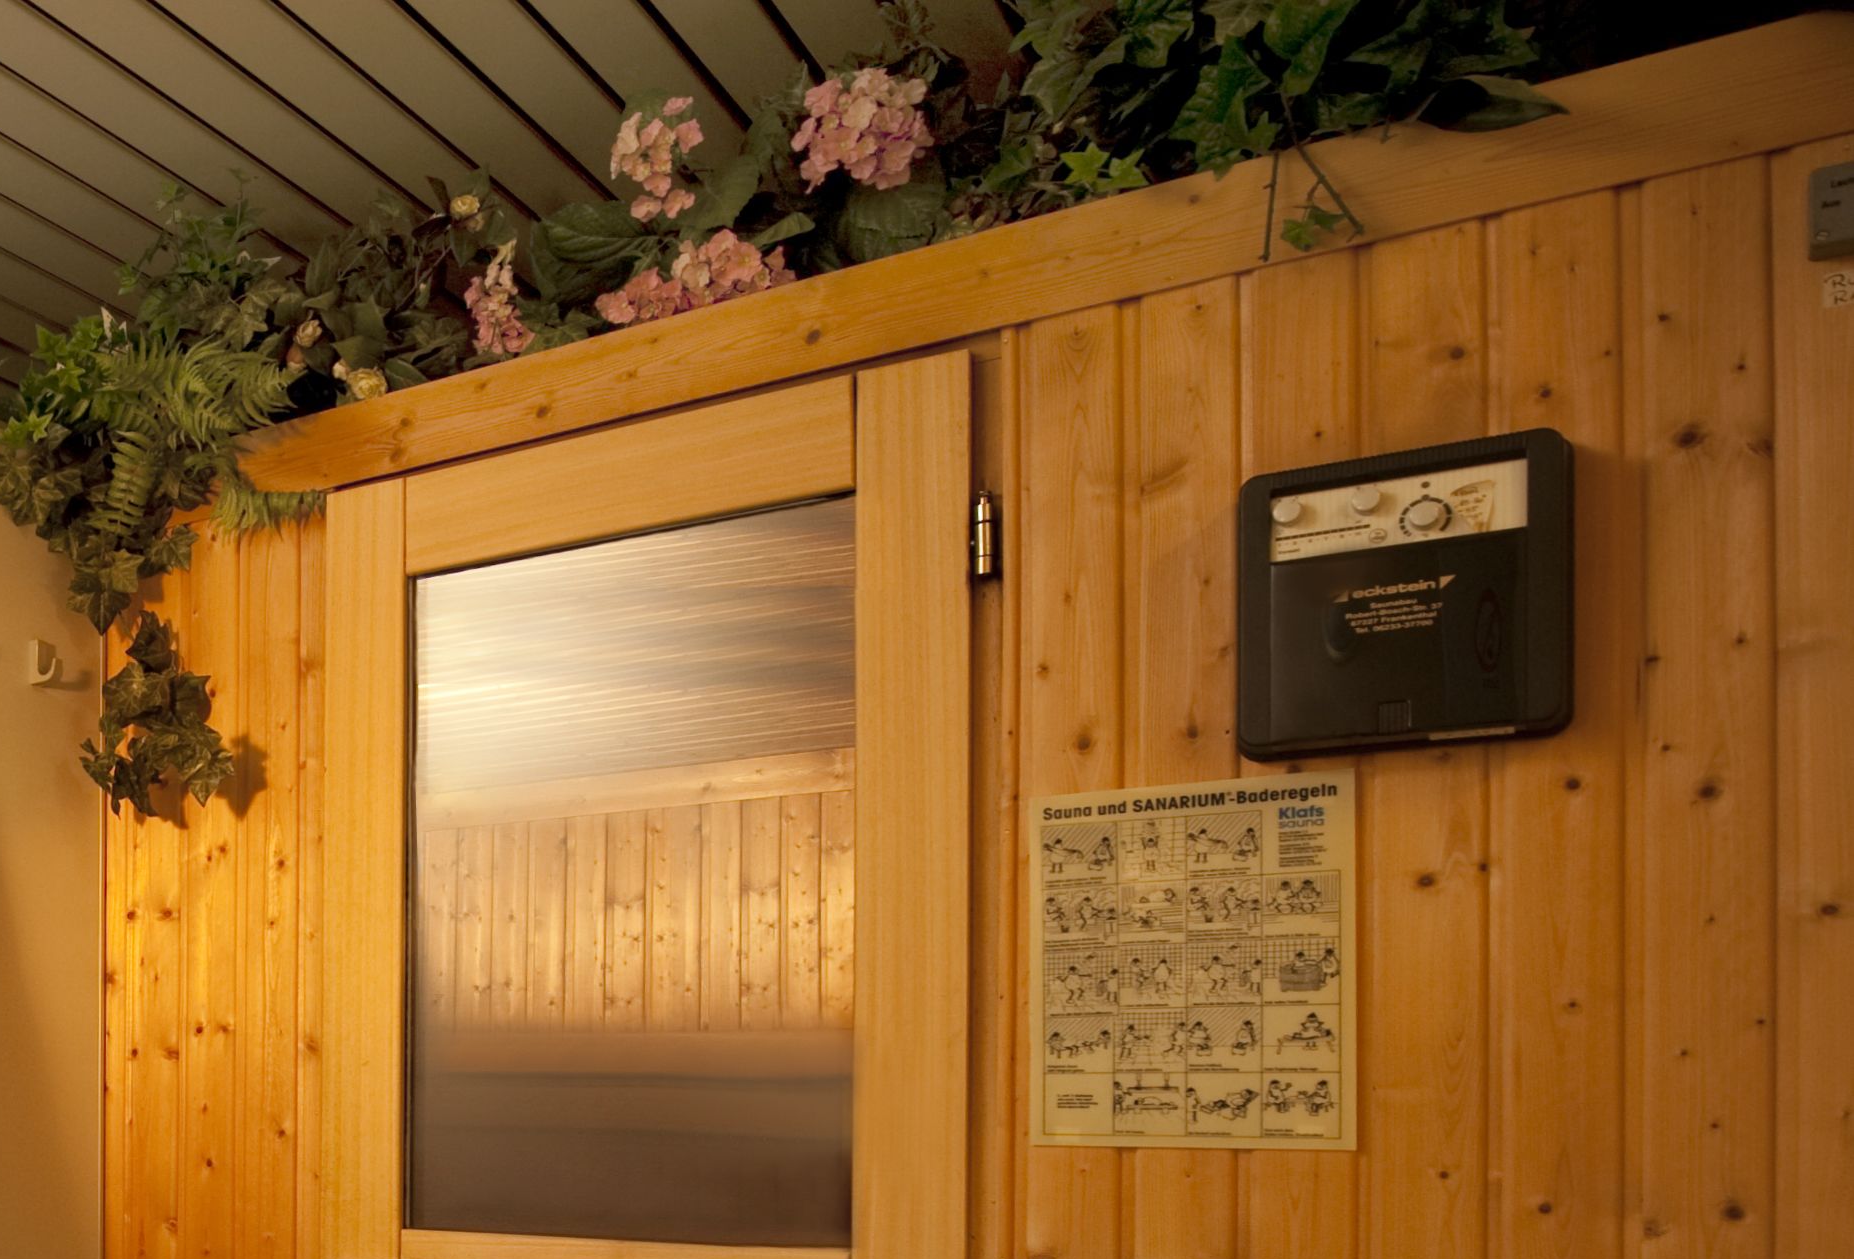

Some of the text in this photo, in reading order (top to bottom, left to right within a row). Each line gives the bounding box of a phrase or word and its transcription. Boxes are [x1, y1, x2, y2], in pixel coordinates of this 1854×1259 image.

[1352, 580, 1436, 598] eckstein
[1043, 806, 1092, 820] Sauna
[1097, 801, 1127, 815] und
[1278, 805, 1324, 820] Klafs
[1278, 818, 1324, 829] sauna
